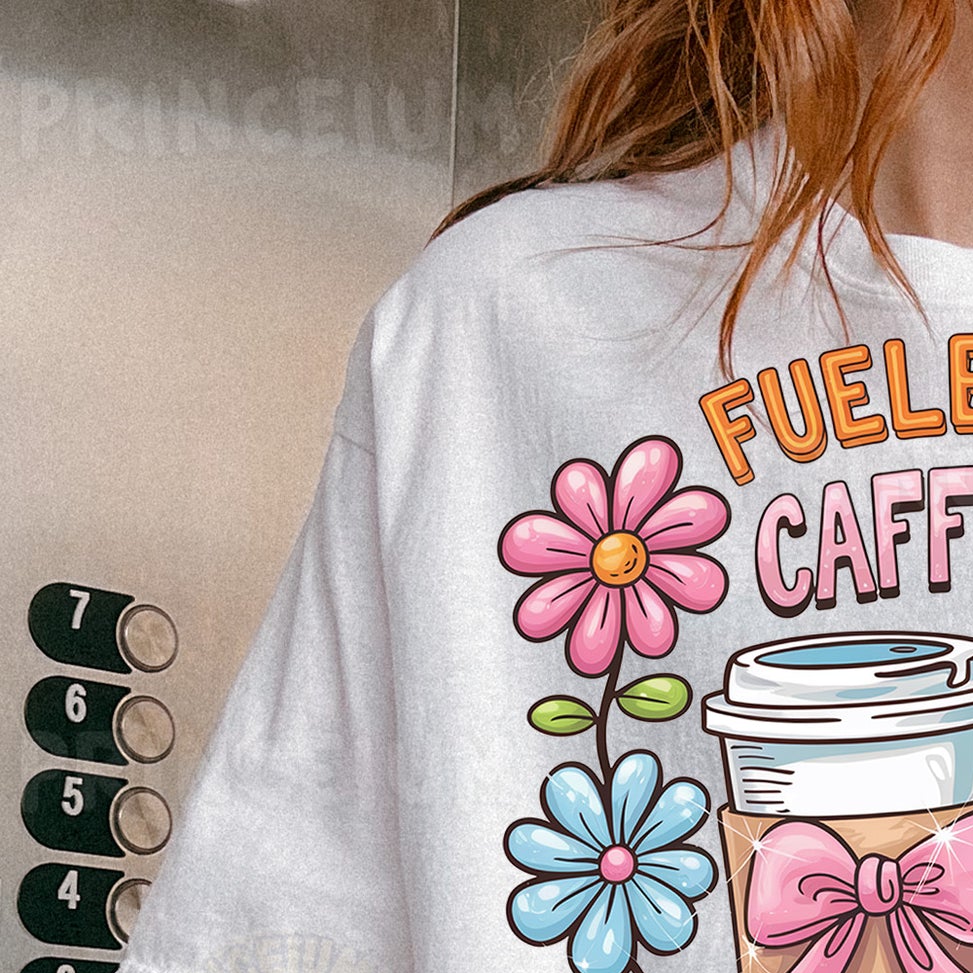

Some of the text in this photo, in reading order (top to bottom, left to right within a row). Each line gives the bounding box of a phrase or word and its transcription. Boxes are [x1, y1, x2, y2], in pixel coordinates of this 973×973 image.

[69, 589, 90, 630] 7
[65, 683, 87, 723] 6
[61, 776, 84, 817] 5
[57, 870, 81, 910] 4
